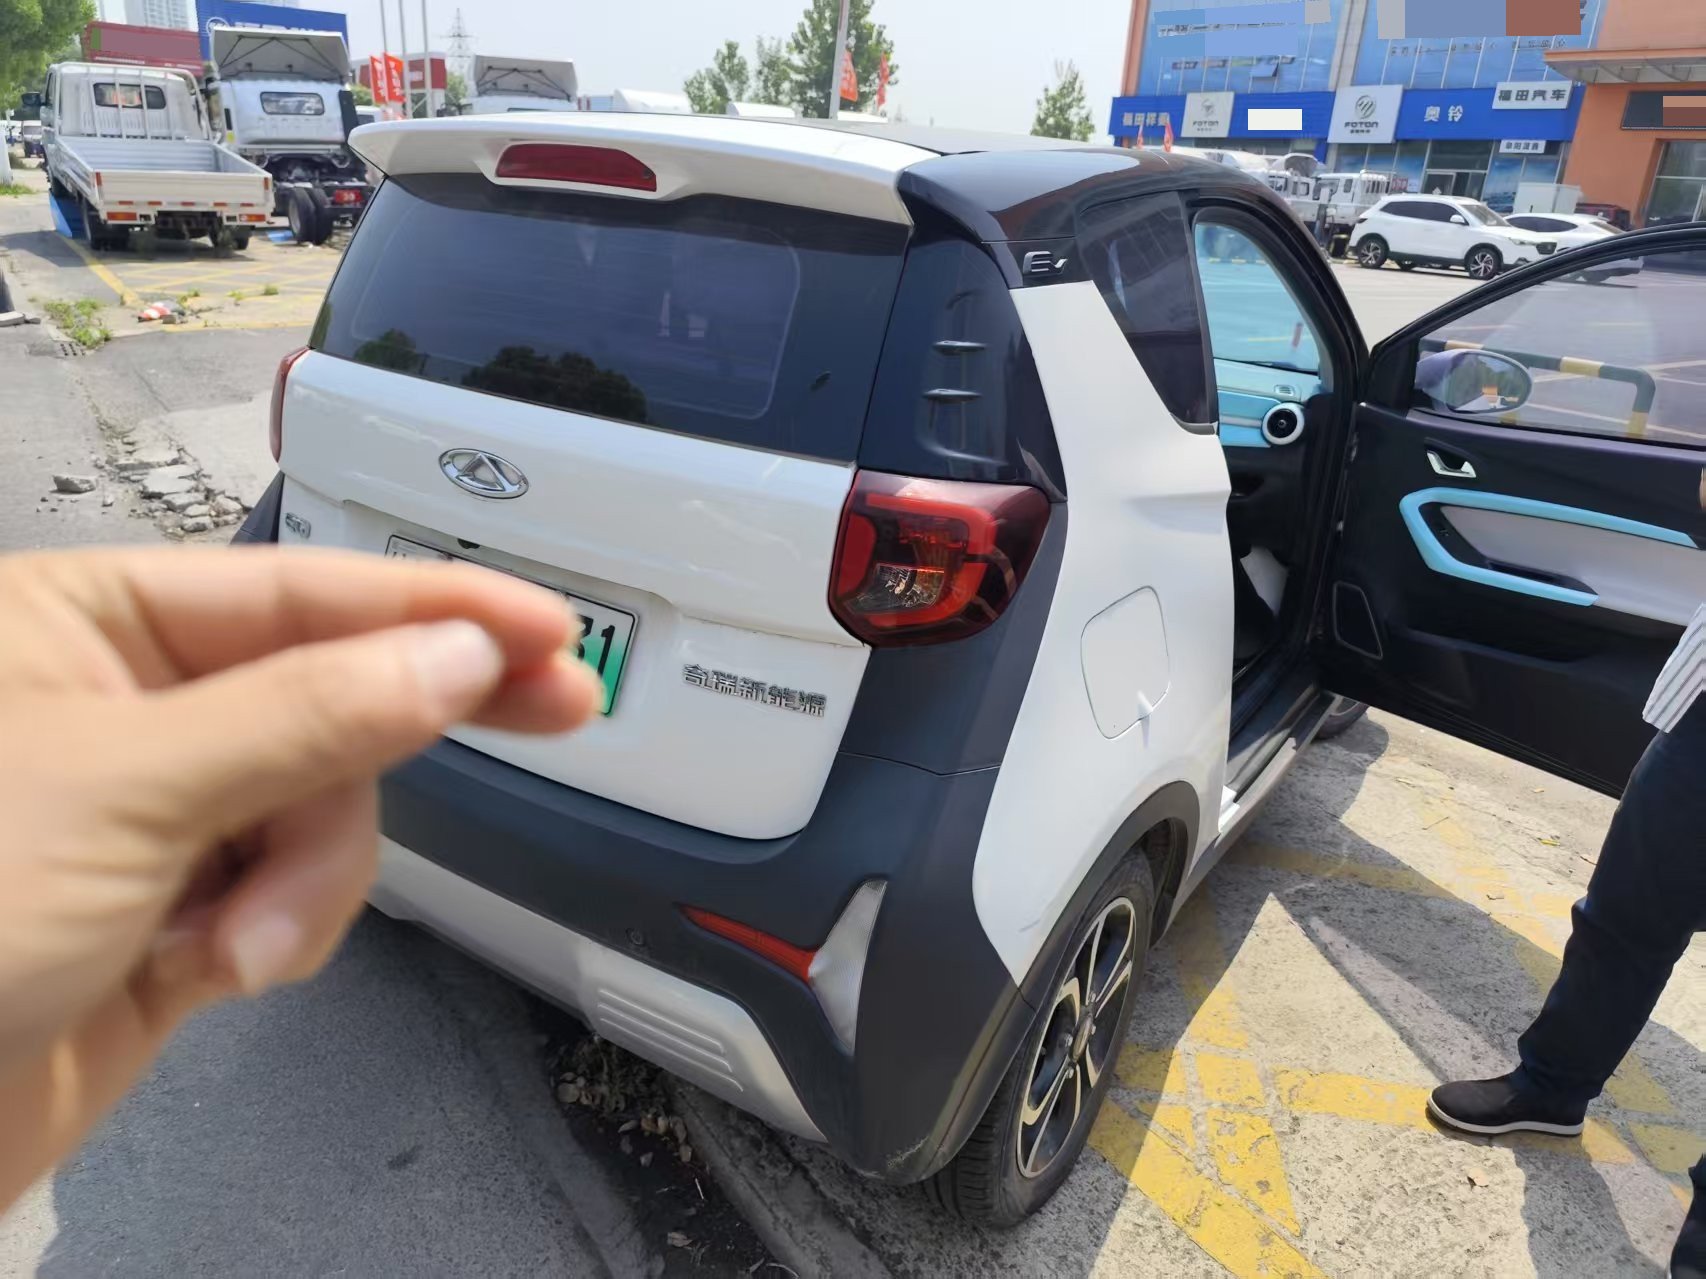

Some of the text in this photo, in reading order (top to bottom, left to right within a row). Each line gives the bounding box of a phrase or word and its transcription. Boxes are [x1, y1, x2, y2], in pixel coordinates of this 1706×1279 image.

[1424, 105, 1463, 122] 奥铃
[683, 664, 827, 717] 奇瑞新能源
